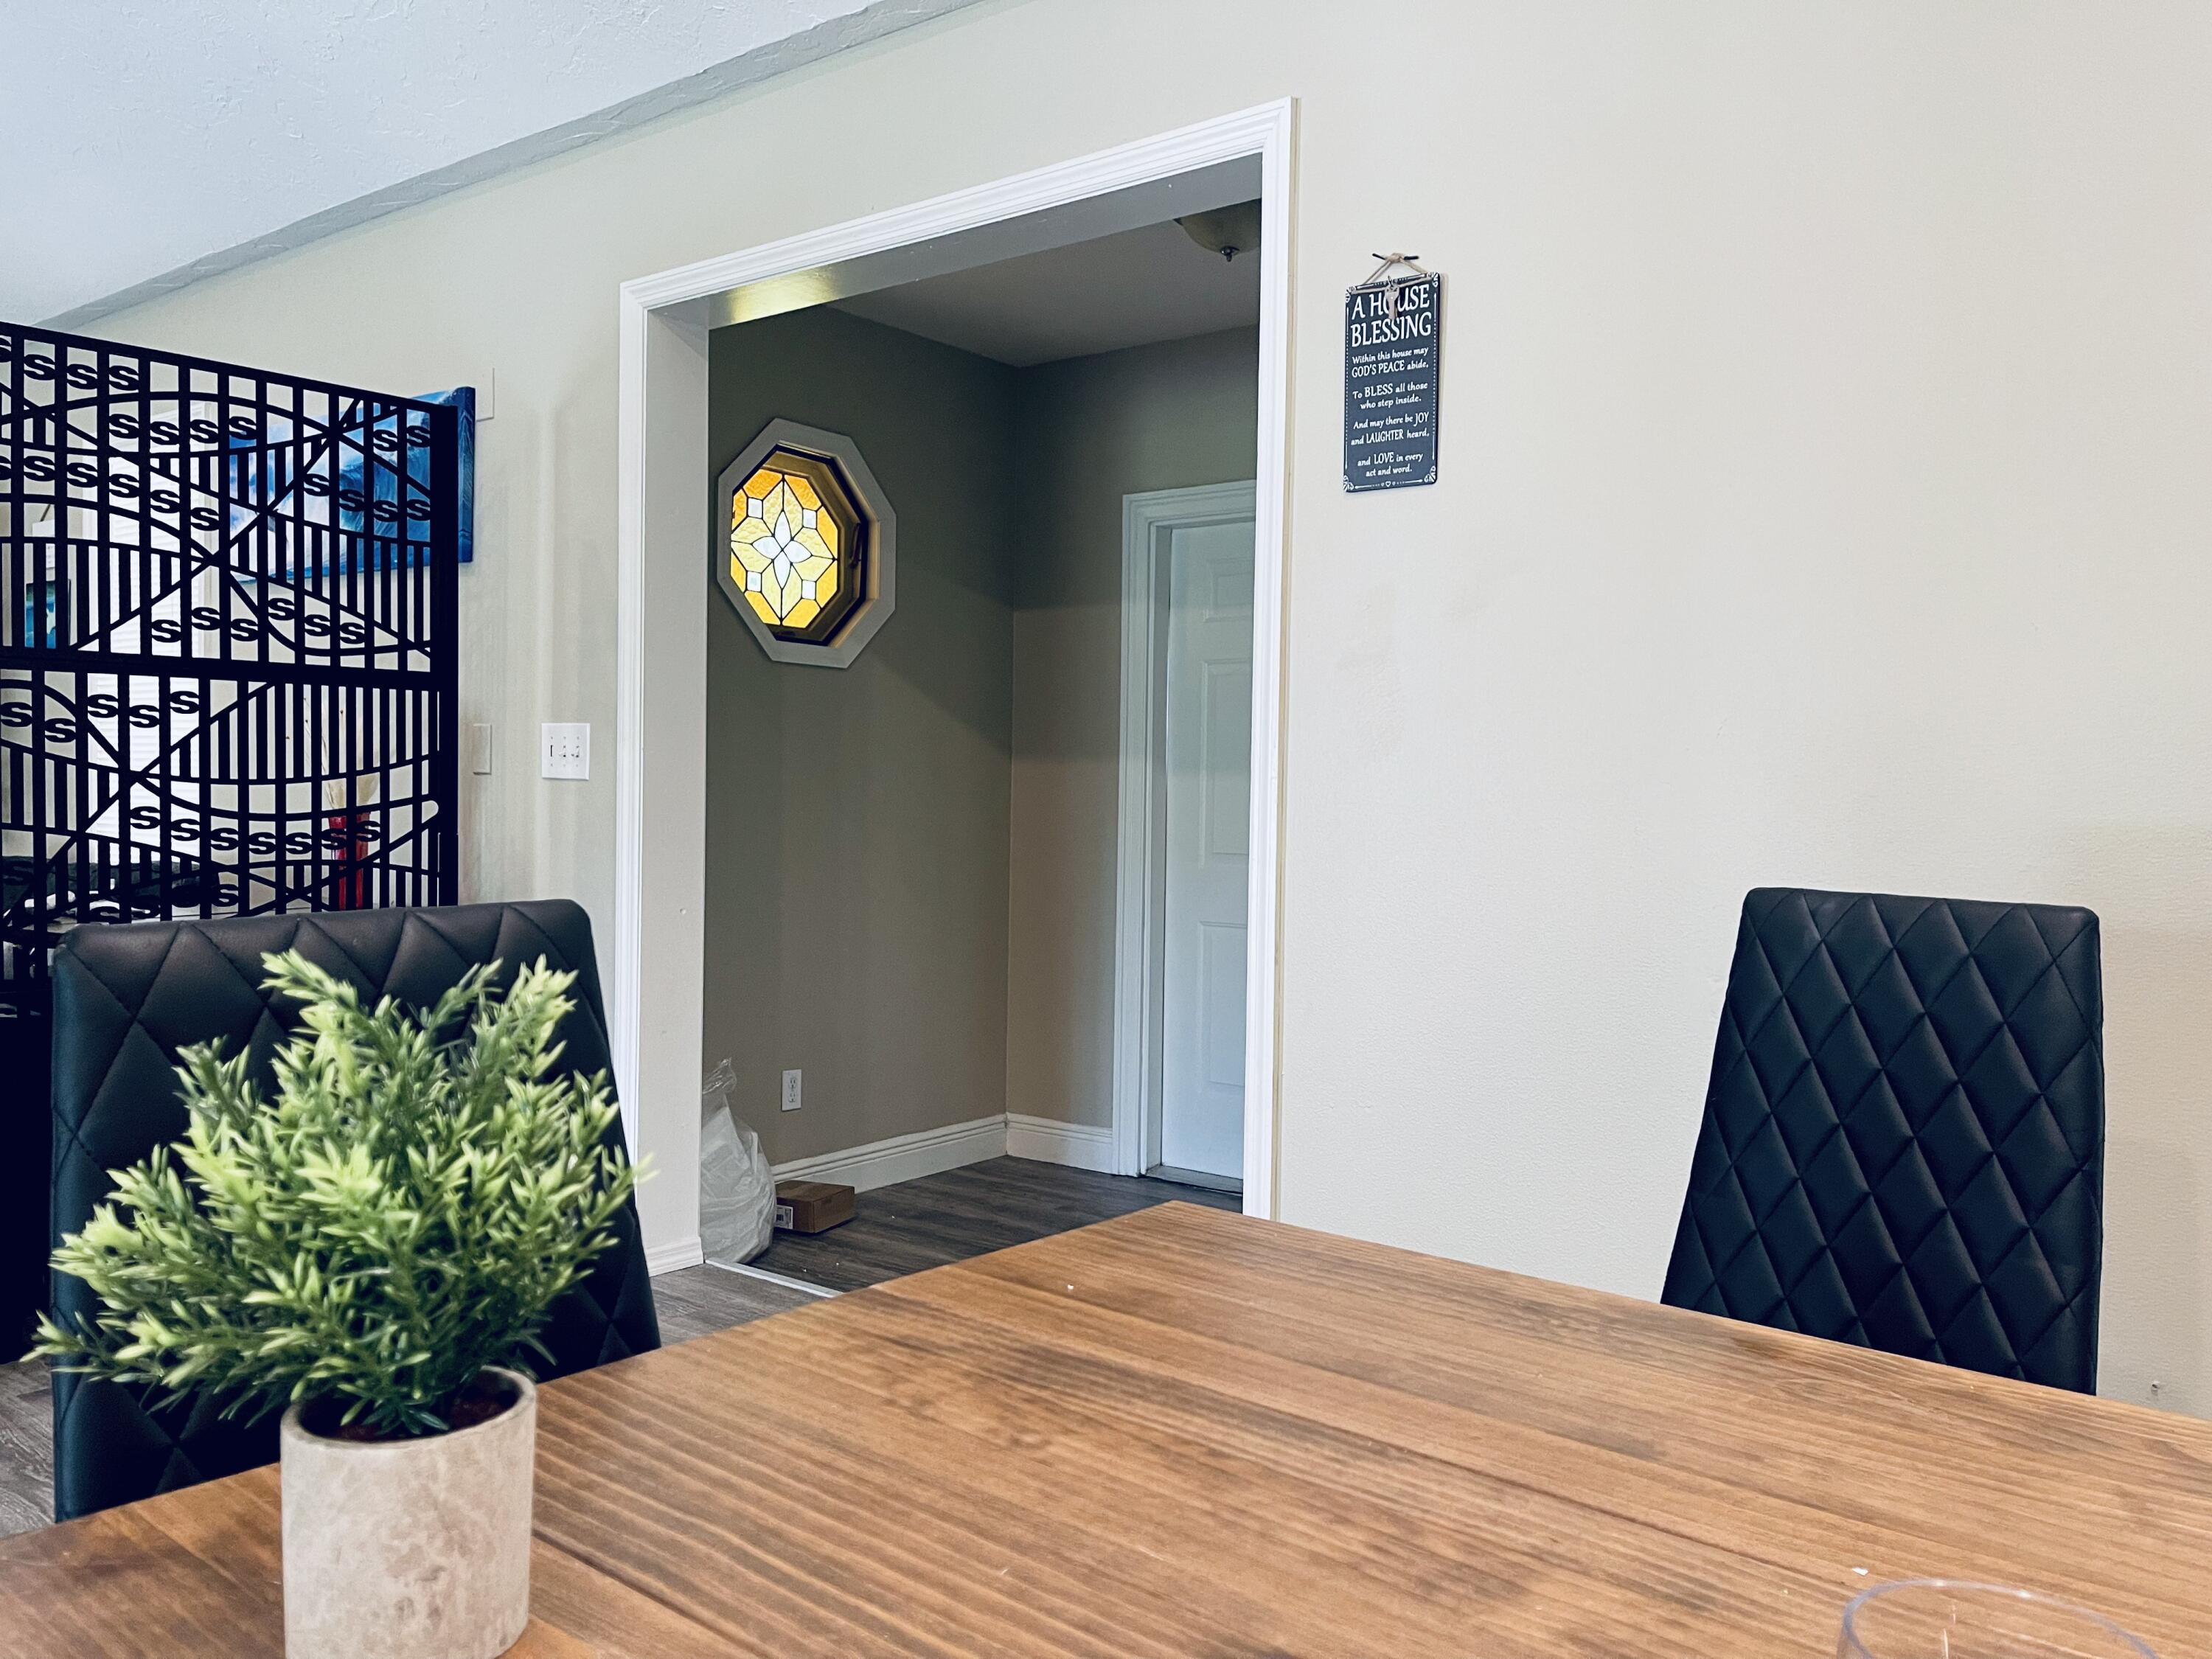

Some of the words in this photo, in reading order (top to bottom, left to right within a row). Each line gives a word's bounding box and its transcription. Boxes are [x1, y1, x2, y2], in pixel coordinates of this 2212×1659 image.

[1352, 296, 1366, 320] A
[1351, 312, 1432, 347] BLESSING
[1352, 353, 1376, 364] Within
[1377, 350, 1391, 361] this
[1392, 349, 1412, 358] house
[1413, 347, 1429, 356] may
[1352, 364, 1377, 378] GOD'S
[1378, 360, 1405, 374] PEACE
[1407, 359, 1429, 370] abide.
[1352, 391, 1363, 400] To
[1364, 383, 1394, 397] BLESS
[1395, 383, 1405, 392] all
[1407, 381, 1428, 391] those
[1360, 400, 1376, 409] who
[1377, 399, 1394, 408] step
[1396, 394, 1422, 404] inside.
[1353, 419, 1368, 429] And
[1370, 420, 1385, 428] may
[1385, 416, 1404, 425] there
[1405, 414, 1413, 422] be
[1413, 412, 1430, 426] JOY
[1351, 436, 1364, 445] and
[1366, 429, 1404, 444] LAUGHTER
[1357, 456, 1371, 466] and
[1374, 452, 1394, 465] LOVE
[1397, 454, 1404, 462] in
[1405, 453, 1423, 462] every
[1377, 466, 1391, 476] and
[1393, 464, 1413, 474] word.
